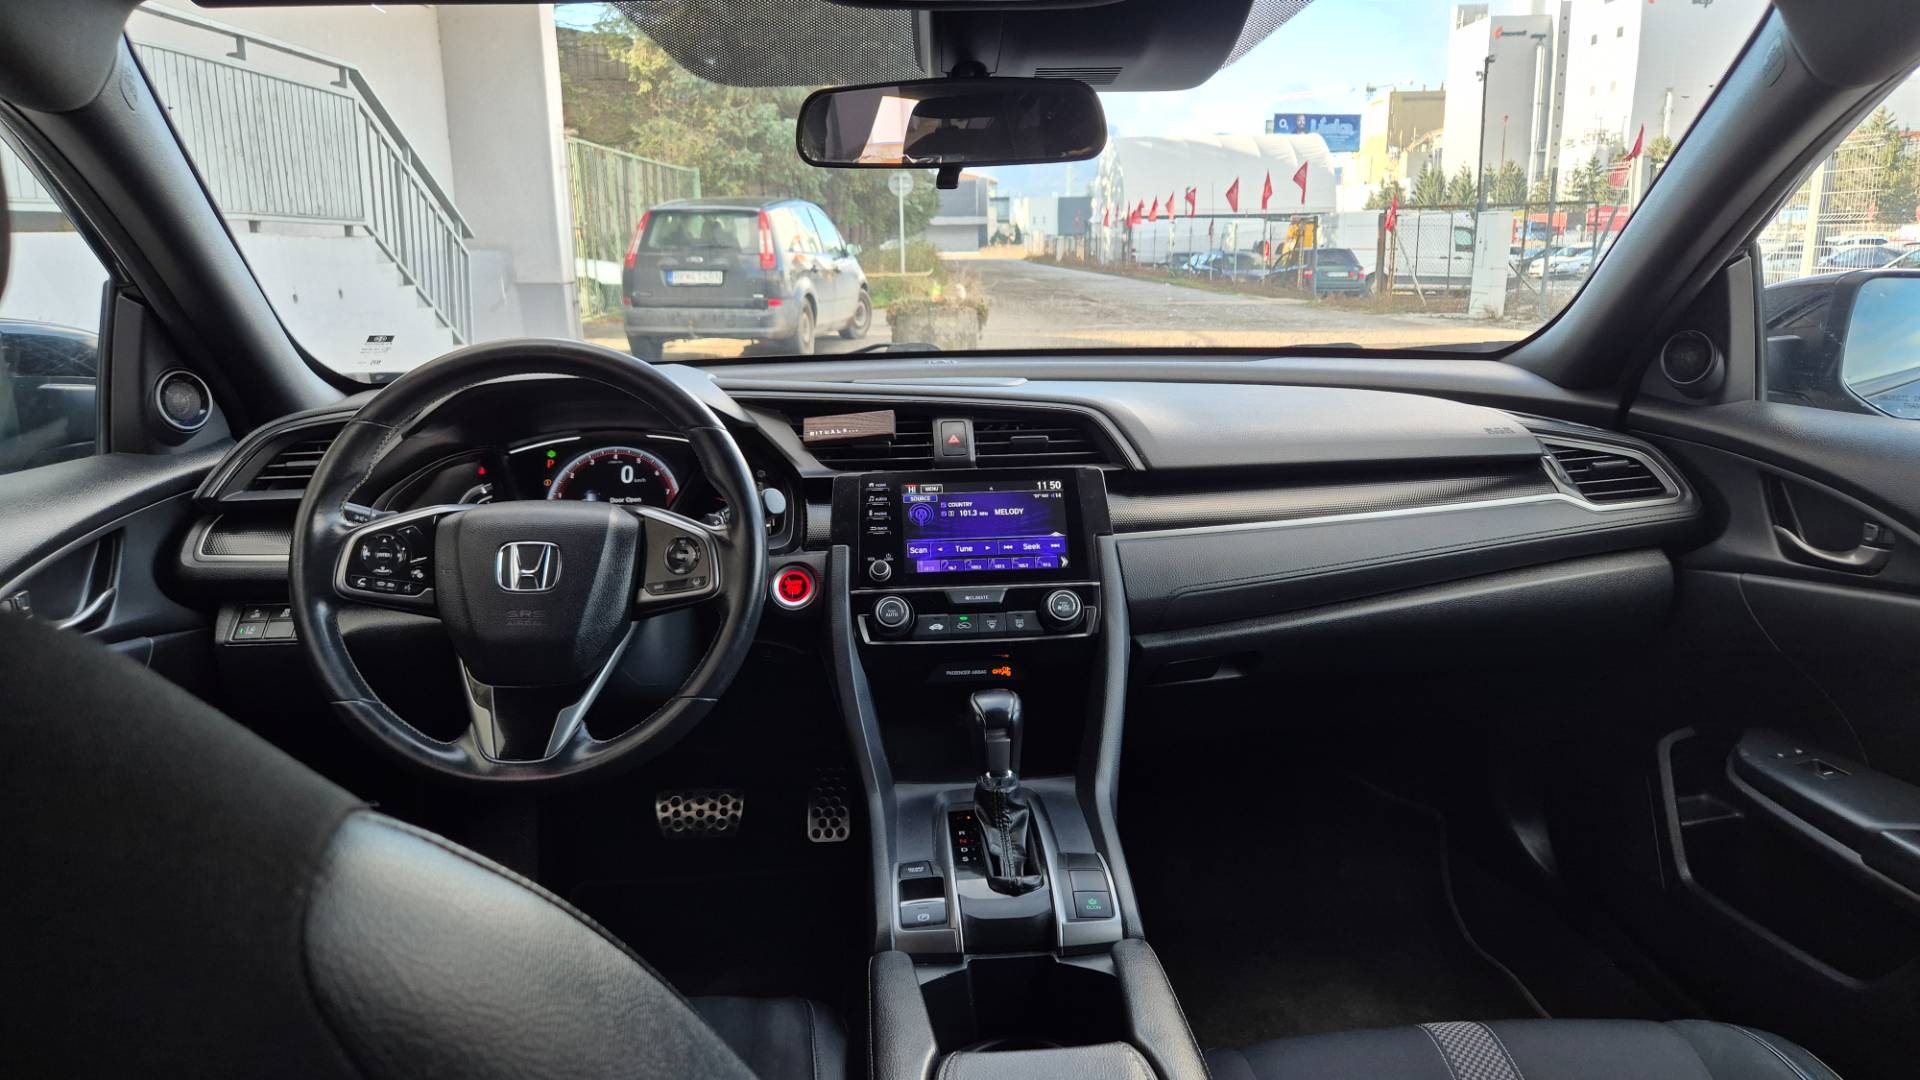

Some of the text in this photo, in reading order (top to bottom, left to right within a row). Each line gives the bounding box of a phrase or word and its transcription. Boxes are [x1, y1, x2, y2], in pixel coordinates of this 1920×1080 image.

[621, 465, 634, 484] 0
[609, 496, 625, 504] Door
[959, 509, 978, 517] 101.3
[994, 508, 1024, 516] MELODY
[909, 546, 928, 554] Scan
